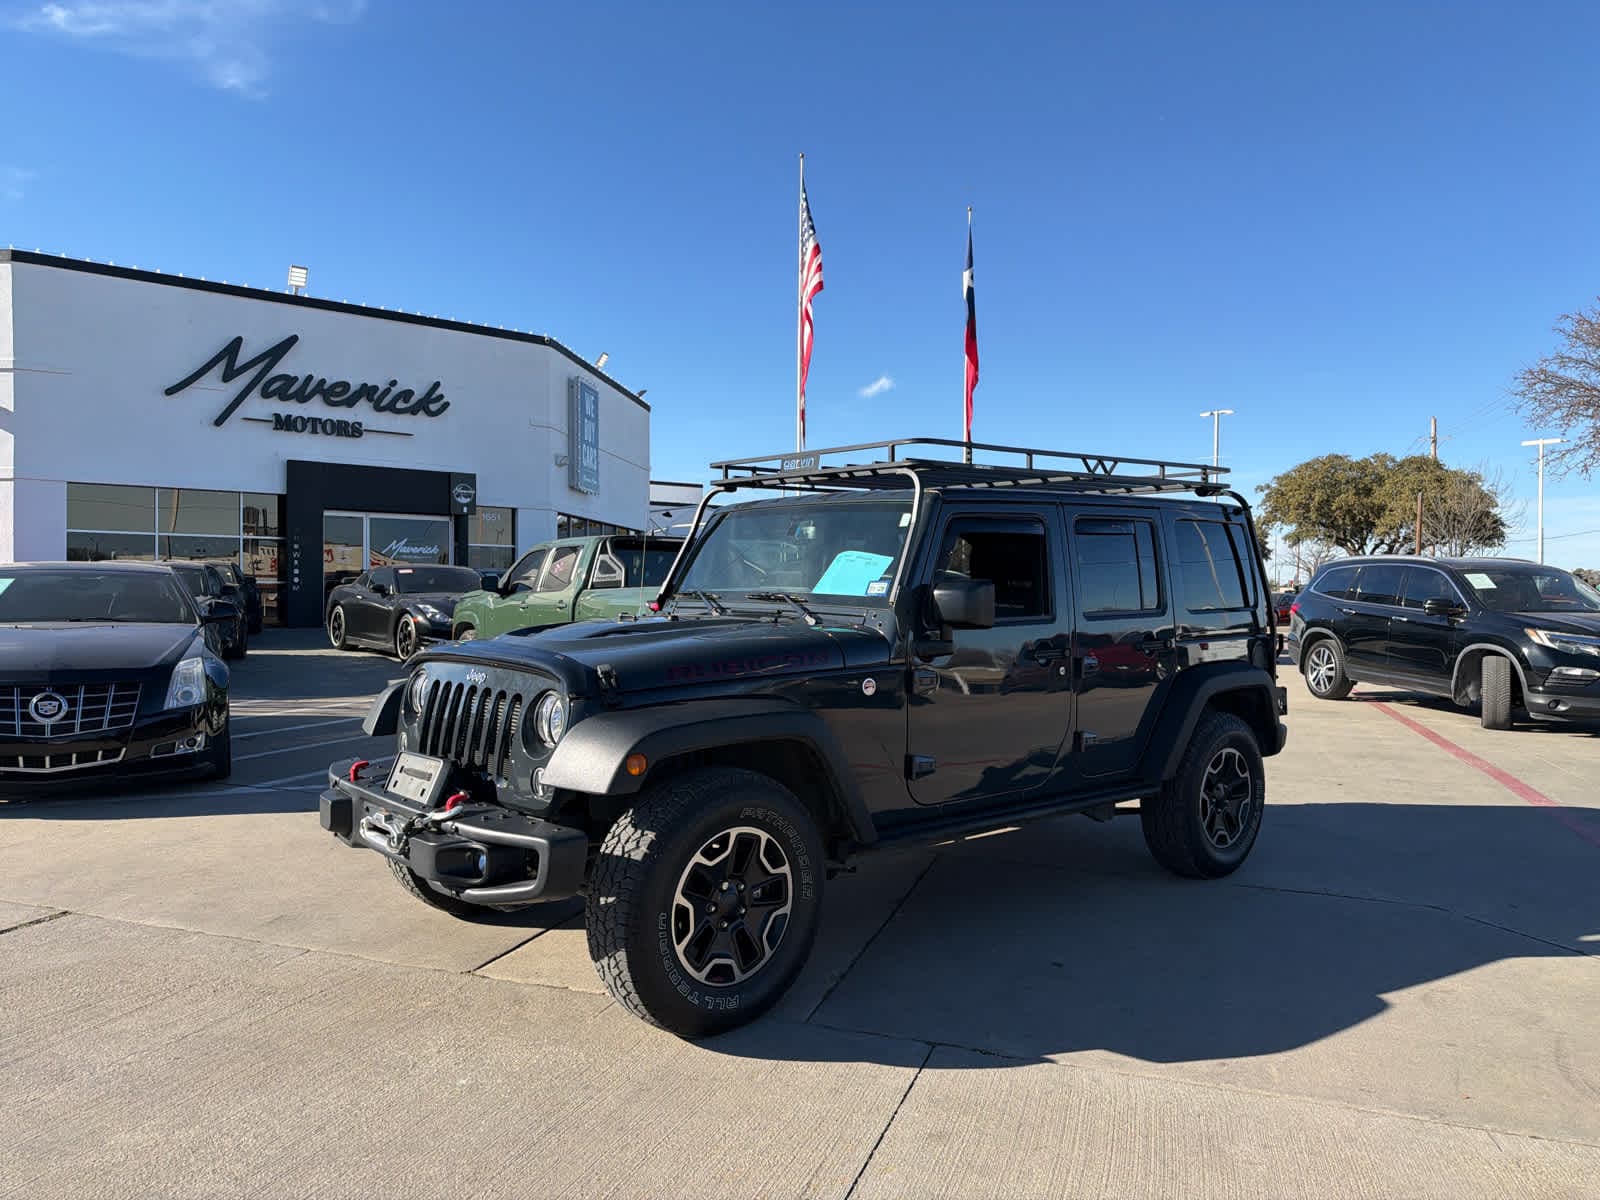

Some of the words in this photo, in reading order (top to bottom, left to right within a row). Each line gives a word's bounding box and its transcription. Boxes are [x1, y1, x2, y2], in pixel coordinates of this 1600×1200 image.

[164, 334, 451, 427] Maverick
[272, 413, 364, 438] MOTORS
[466, 669, 487, 685] Jeep
[704, 995, 740, 1009] ALL
